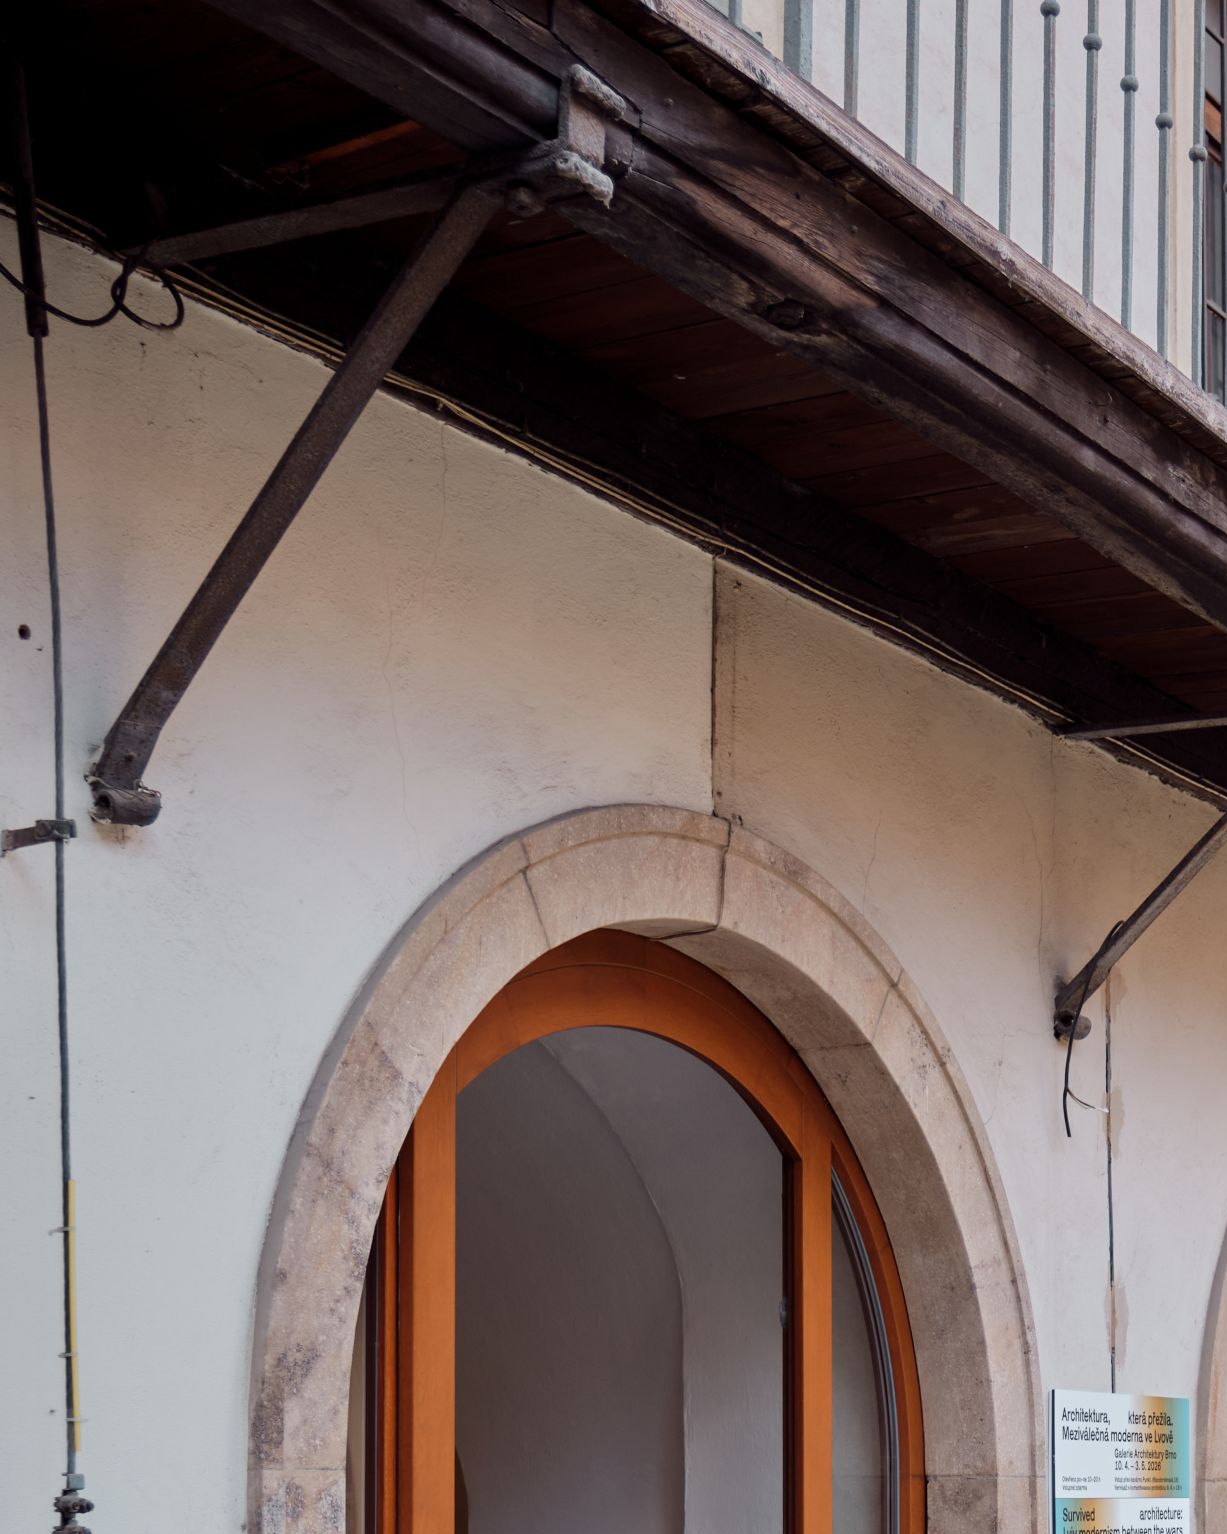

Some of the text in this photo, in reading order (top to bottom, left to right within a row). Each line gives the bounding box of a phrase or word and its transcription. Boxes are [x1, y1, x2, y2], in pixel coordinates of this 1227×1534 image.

[1061, 1406, 1174, 1428] Architektura, která přežila.
[1062, 1425, 1174, 1444] Meziválečná moderna ve Lvově
[1114, 1448, 1177, 1461] Galerie Architektury Brno
[1114, 1460, 1124, 1471] 10.
[1124, 1460, 1130, 1471] 4.
[1135, 1461, 1141, 1471] 3.
[1147, 1461, 1162, 1471] 2026
[1062, 1506, 1183, 1522] Survived architecture:
